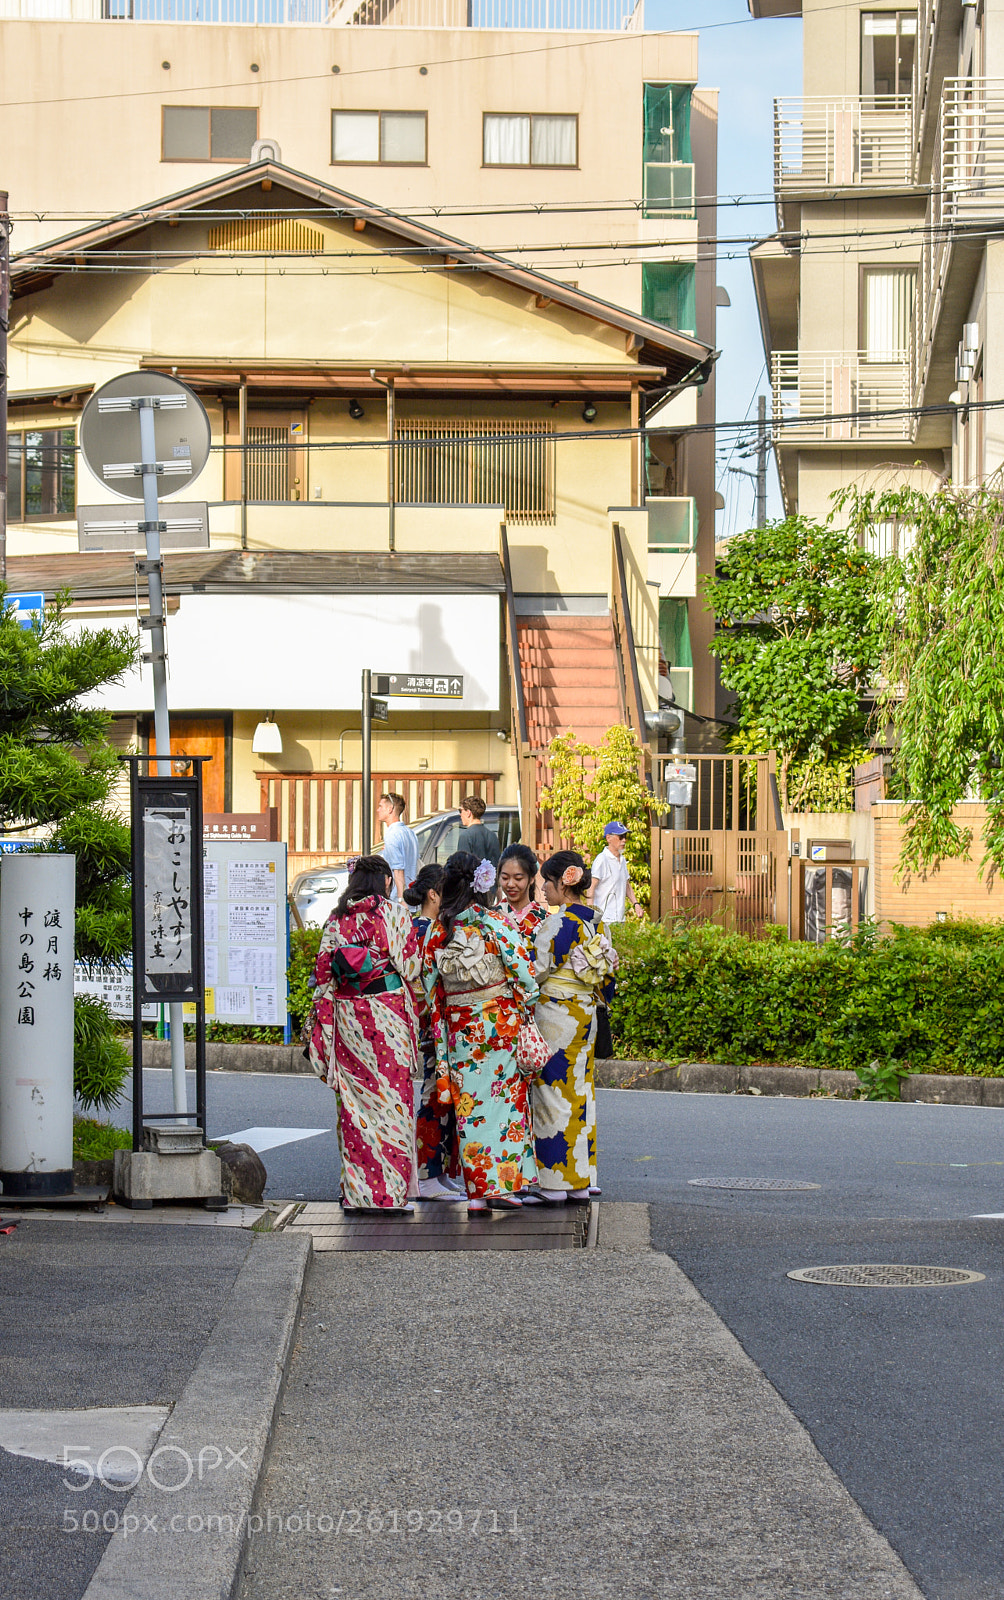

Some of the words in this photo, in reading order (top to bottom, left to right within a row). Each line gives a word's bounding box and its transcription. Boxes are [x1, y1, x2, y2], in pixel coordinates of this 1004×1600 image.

[17, 907, 35, 1026] 中の島公園
[43, 909, 62, 981] 渡月橋
